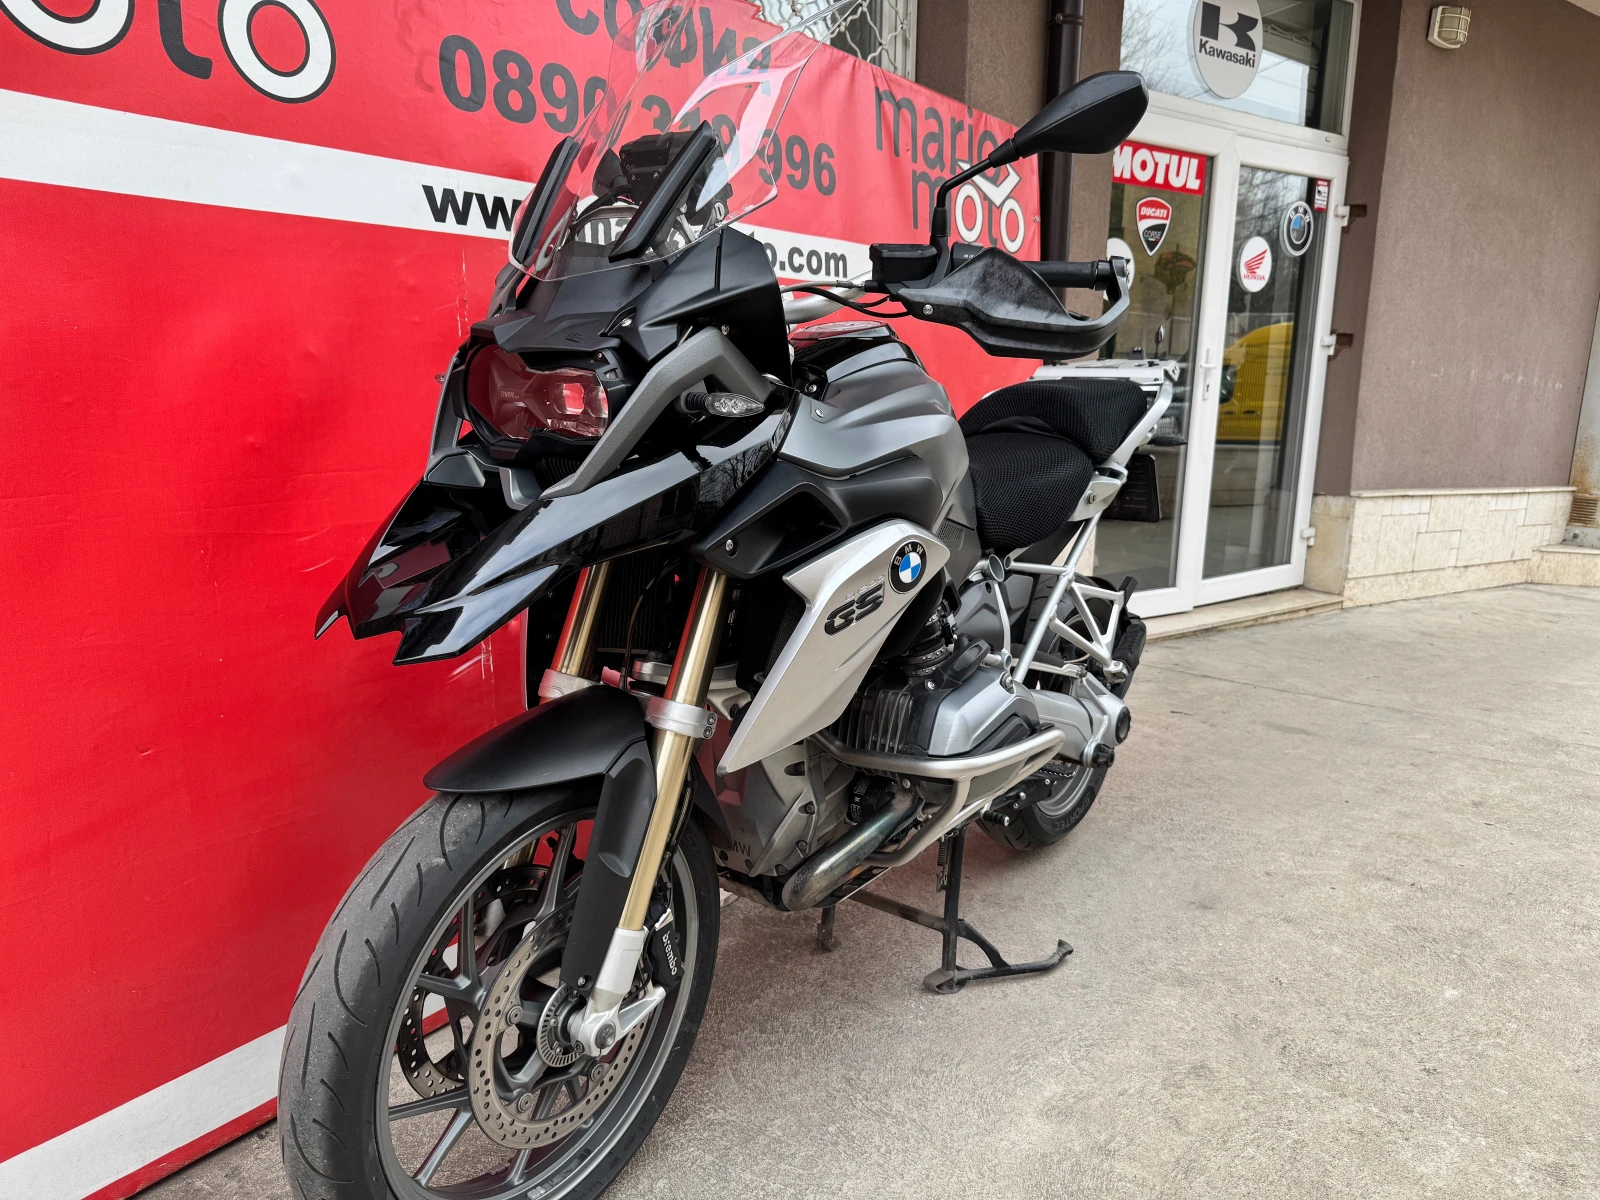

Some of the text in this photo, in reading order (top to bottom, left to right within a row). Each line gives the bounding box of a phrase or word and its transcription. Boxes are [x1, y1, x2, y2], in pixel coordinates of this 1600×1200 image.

[1199, 38, 1256, 69] Kawasaki
[875, 86, 1002, 184] mario
[757, 129, 836, 196] 996
[1112, 145, 1201, 191] MOTUL
[912, 169, 1025, 253] moto
[1140, 206, 1168, 218] DUCATI
[1143, 229, 1162, 238] CORSE
[1243, 273, 1266, 281] HONDA
[893, 543, 924, 566] BMW
[824, 583, 885, 636] GS
[662, 931, 677, 976] brembo
